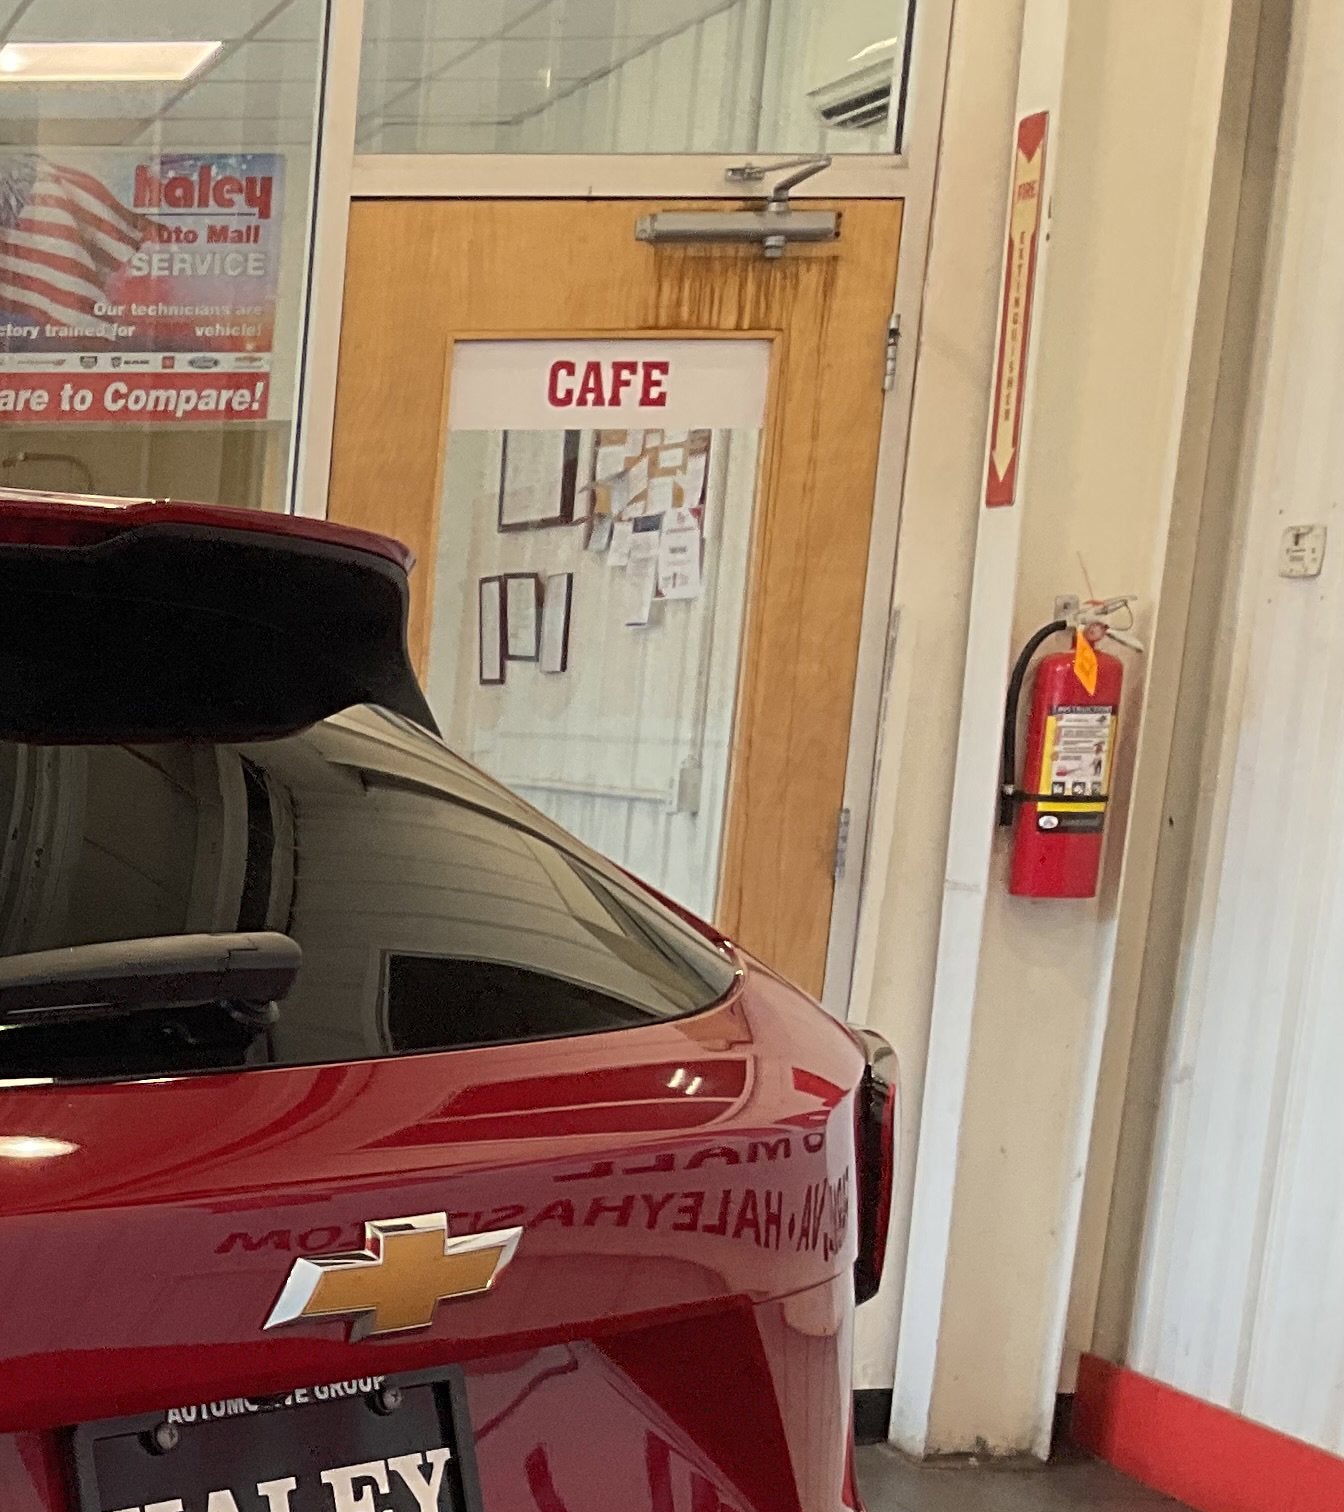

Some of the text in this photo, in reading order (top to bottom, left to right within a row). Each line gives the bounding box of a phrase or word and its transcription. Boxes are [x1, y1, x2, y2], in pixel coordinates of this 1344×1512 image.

[133, 164, 273, 219] haley
[207, 225, 260, 244] Mall
[129, 253, 265, 277] SERVICE
[93, 302, 263, 316] Our technicians are
[45, 322, 107, 338] trained
[111, 322, 136, 340] for
[547, 360, 671, 408] CAFE
[61, 383, 94, 412] to
[104, 380, 265, 418] Compare!
[314, 1375, 387, 1402] GROUP
